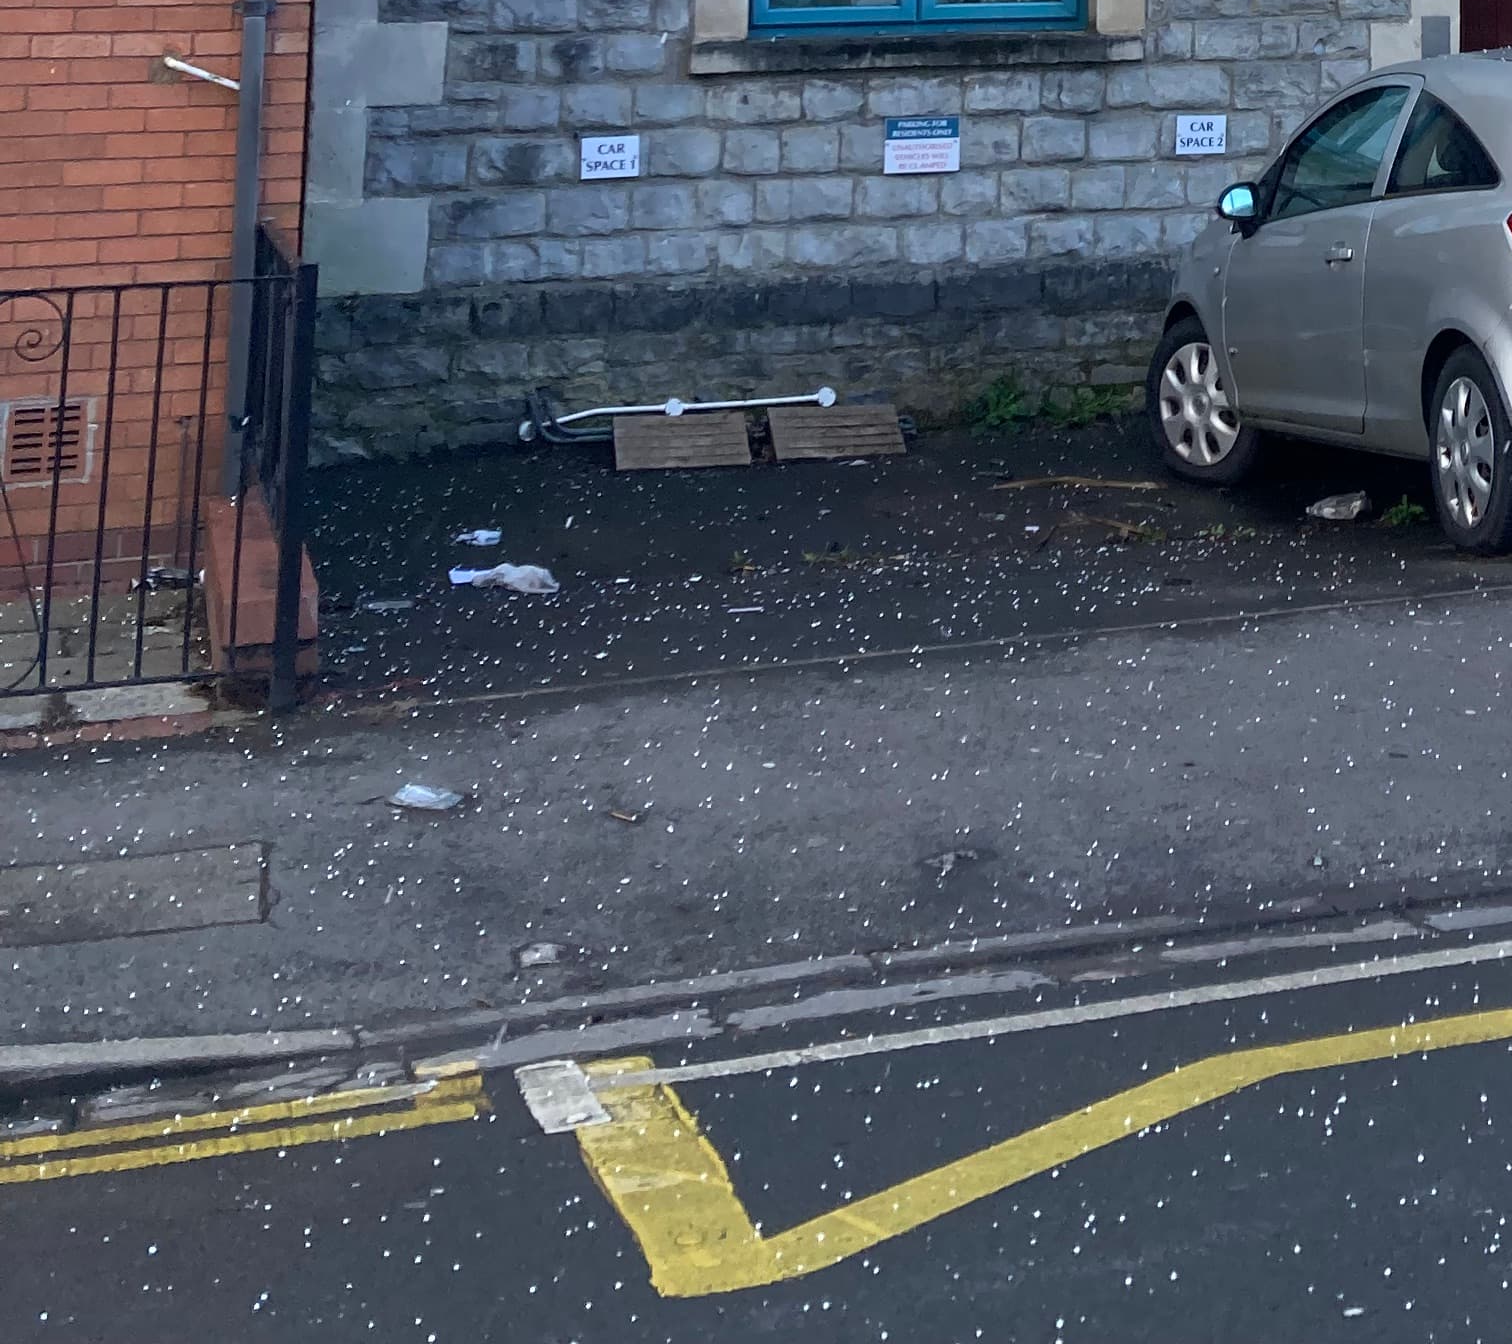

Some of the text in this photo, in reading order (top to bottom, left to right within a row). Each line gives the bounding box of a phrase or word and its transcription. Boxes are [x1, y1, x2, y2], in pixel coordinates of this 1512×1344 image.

[1190, 121, 1214, 132] CAR
[1180, 137, 1224, 148] SPACE 2
[597, 143, 626, 155] CAR
[585, 159, 636, 173] SPACE 1
